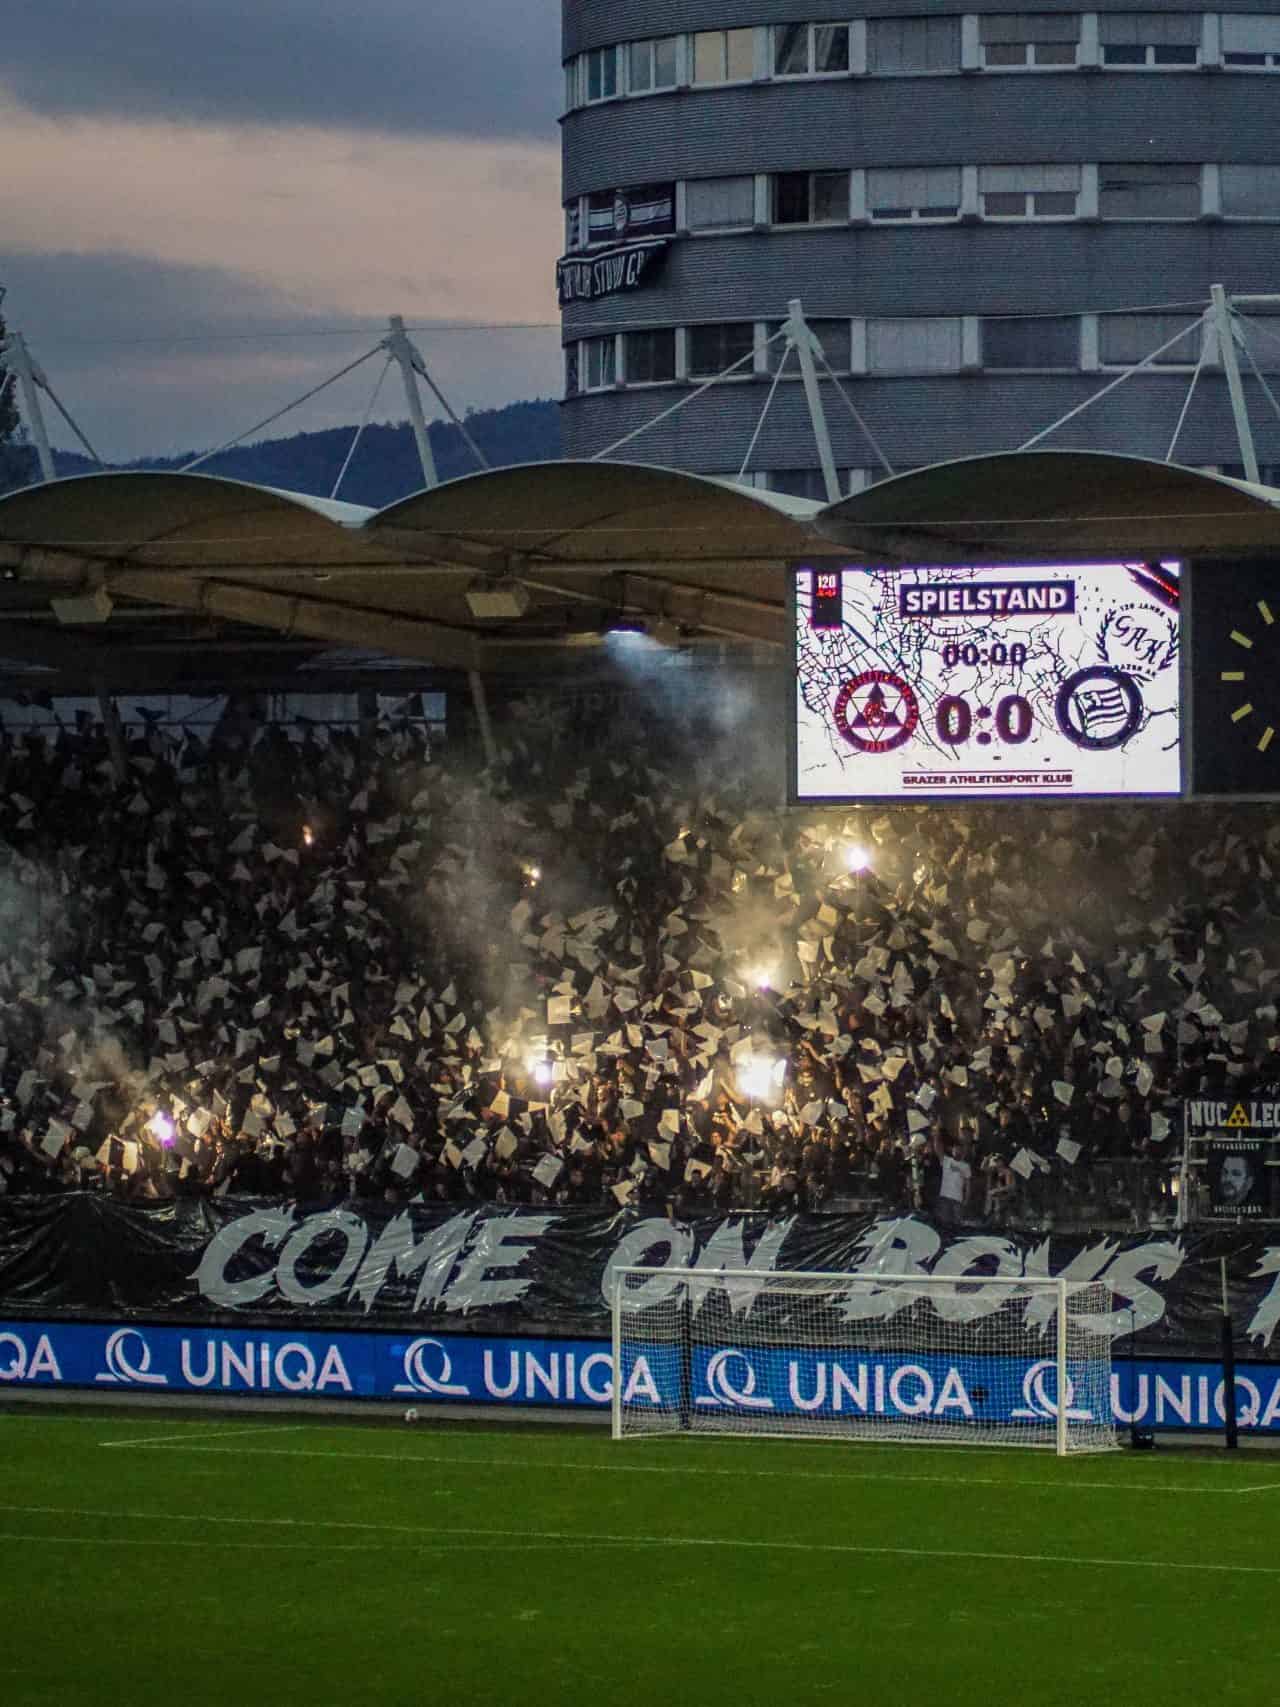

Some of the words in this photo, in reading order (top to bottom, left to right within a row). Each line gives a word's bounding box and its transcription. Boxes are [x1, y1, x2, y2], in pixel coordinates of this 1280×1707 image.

[906, 587, 1067, 612] SPIELSTAND
[943, 642, 1027, 667] 00:00
[1111, 615, 1168, 665] GAK
[936, 694, 1034, 746] 0:0
[903, 774, 947, 785] GRAZER
[950, 774, 1039, 785] ATHLETIKSPORT
[1042, 774, 1073, 784] KLUB
[187, 1206, 567, 1315] COME
[601, 1214, 797, 1320] ON
[840, 1214, 1185, 1337] BOYS
[181, 1339, 352, 1390] UNIQA
[484, 1350, 661, 1403] UNIQA
[789, 1362, 974, 1416] UNIQA
